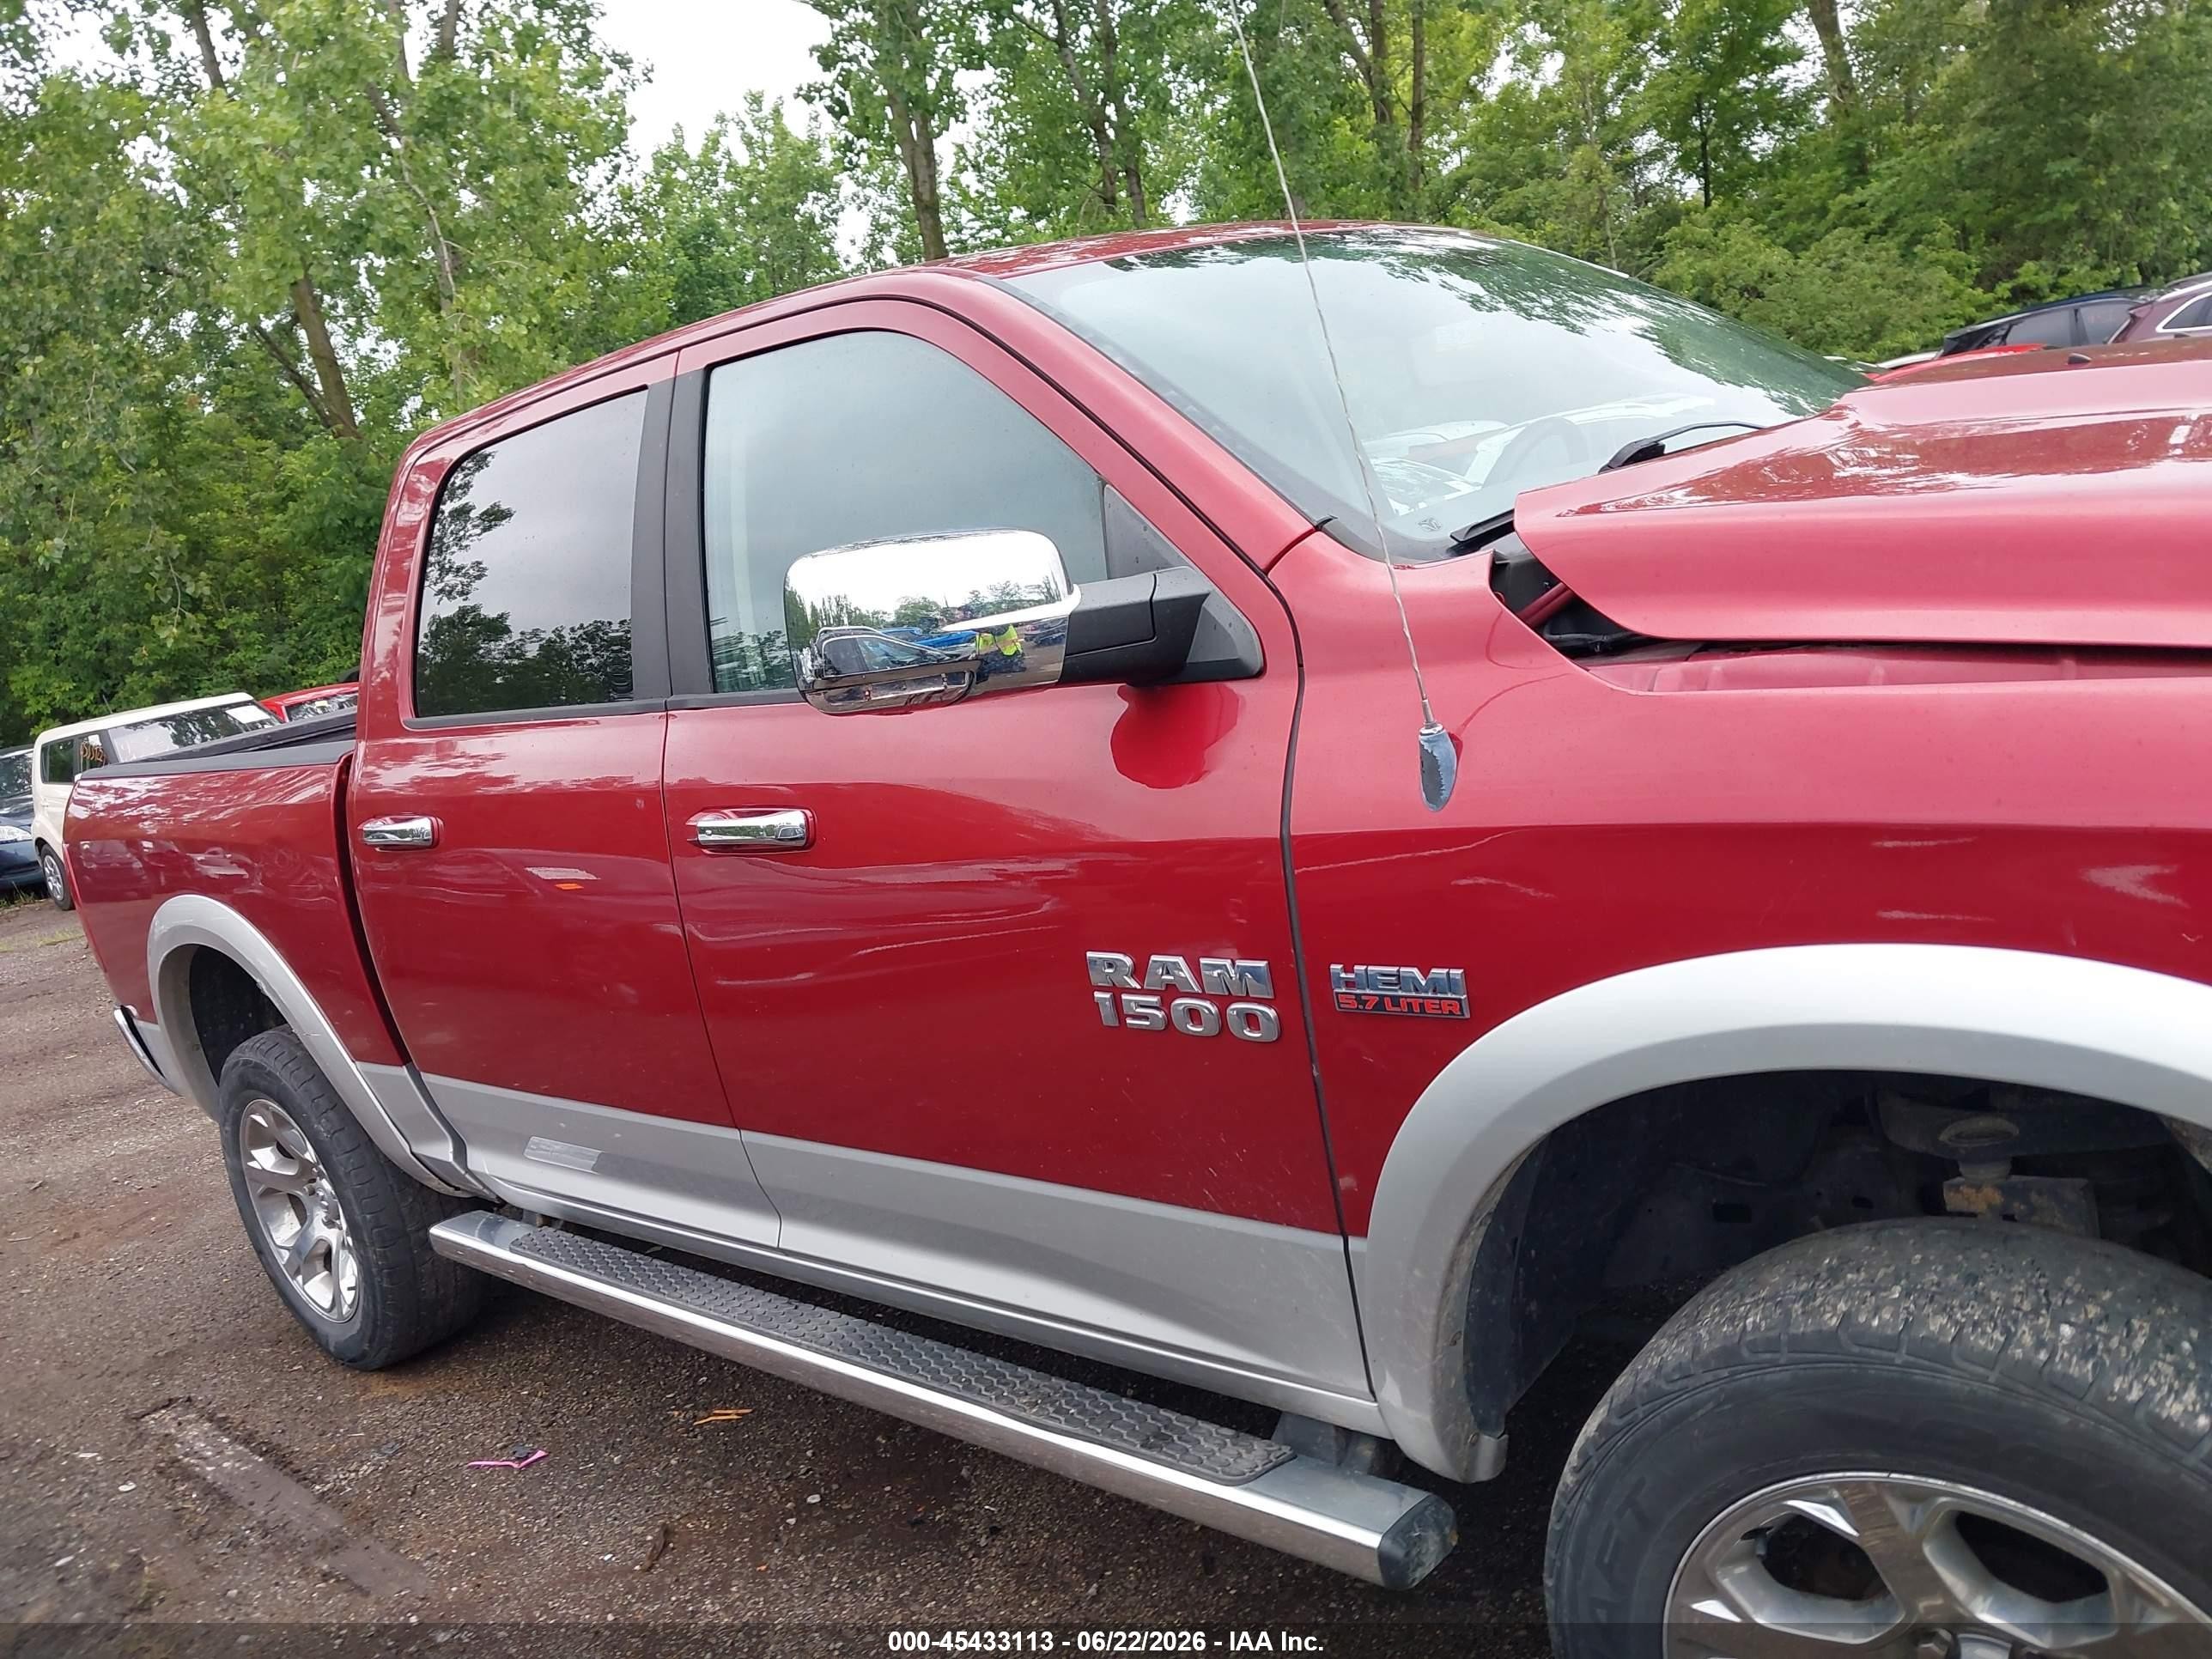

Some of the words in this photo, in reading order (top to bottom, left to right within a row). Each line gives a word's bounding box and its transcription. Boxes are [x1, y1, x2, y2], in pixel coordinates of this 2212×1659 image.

[1086, 951, 1275, 1000] RAM
[1330, 963, 1467, 997] HEMI
[1093, 990, 1282, 1043] 1500
[1338, 994, 1379, 1010] 5.7
[1383, 996, 1462, 1015] LITER
